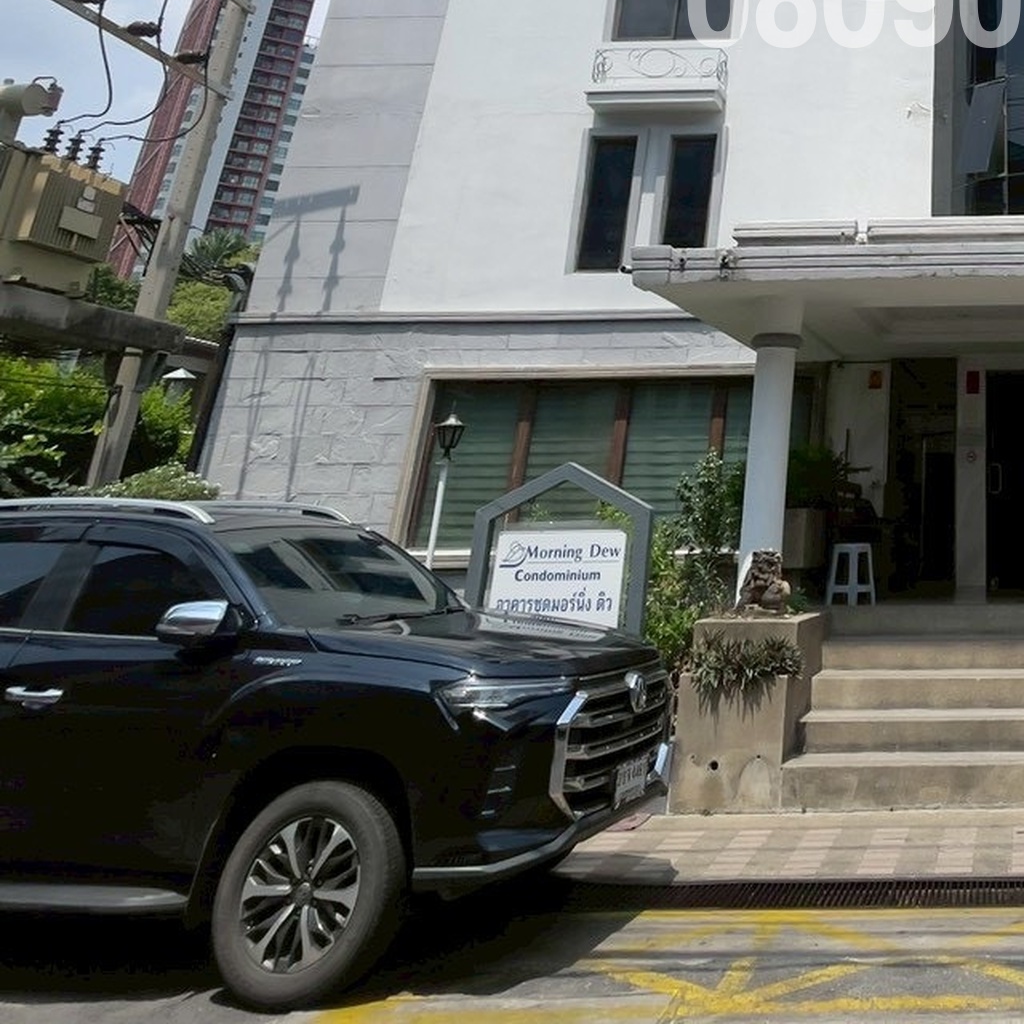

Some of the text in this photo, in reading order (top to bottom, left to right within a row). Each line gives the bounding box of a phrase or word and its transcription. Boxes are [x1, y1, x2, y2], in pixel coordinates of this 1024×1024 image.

[526, 543, 621, 562] Morning Dew
[514, 569, 601, 582] Condominium
[496, 587, 592, 613] อาคารชดมอร์นิ่ง
